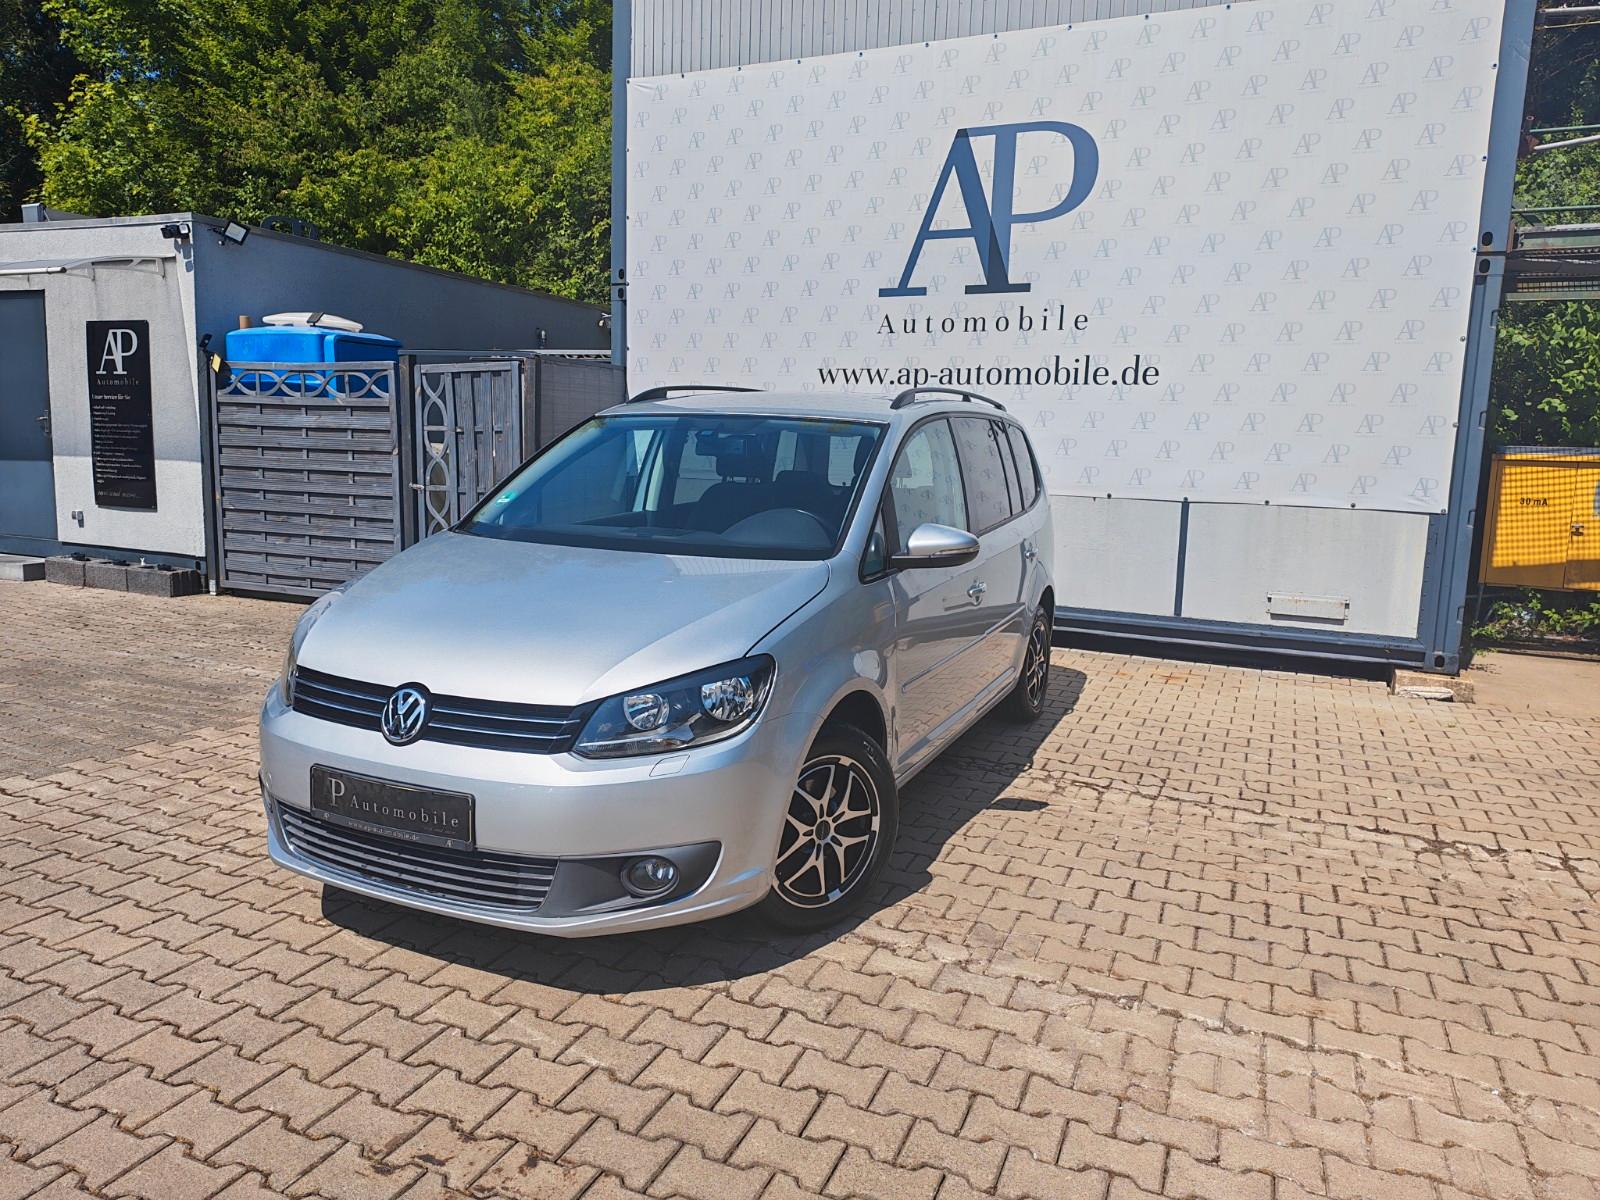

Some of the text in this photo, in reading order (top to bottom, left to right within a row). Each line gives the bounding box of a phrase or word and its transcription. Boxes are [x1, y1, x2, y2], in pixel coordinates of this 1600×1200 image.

[878, 120, 1099, 298] AP
[877, 305, 1088, 335] Automobile
[96, 329, 138, 374] AP
[818, 355, 1160, 388] www.ap-automobile.de
[1520, 497, 1531, 505] 30
[351, 795, 459, 827] Automobile
